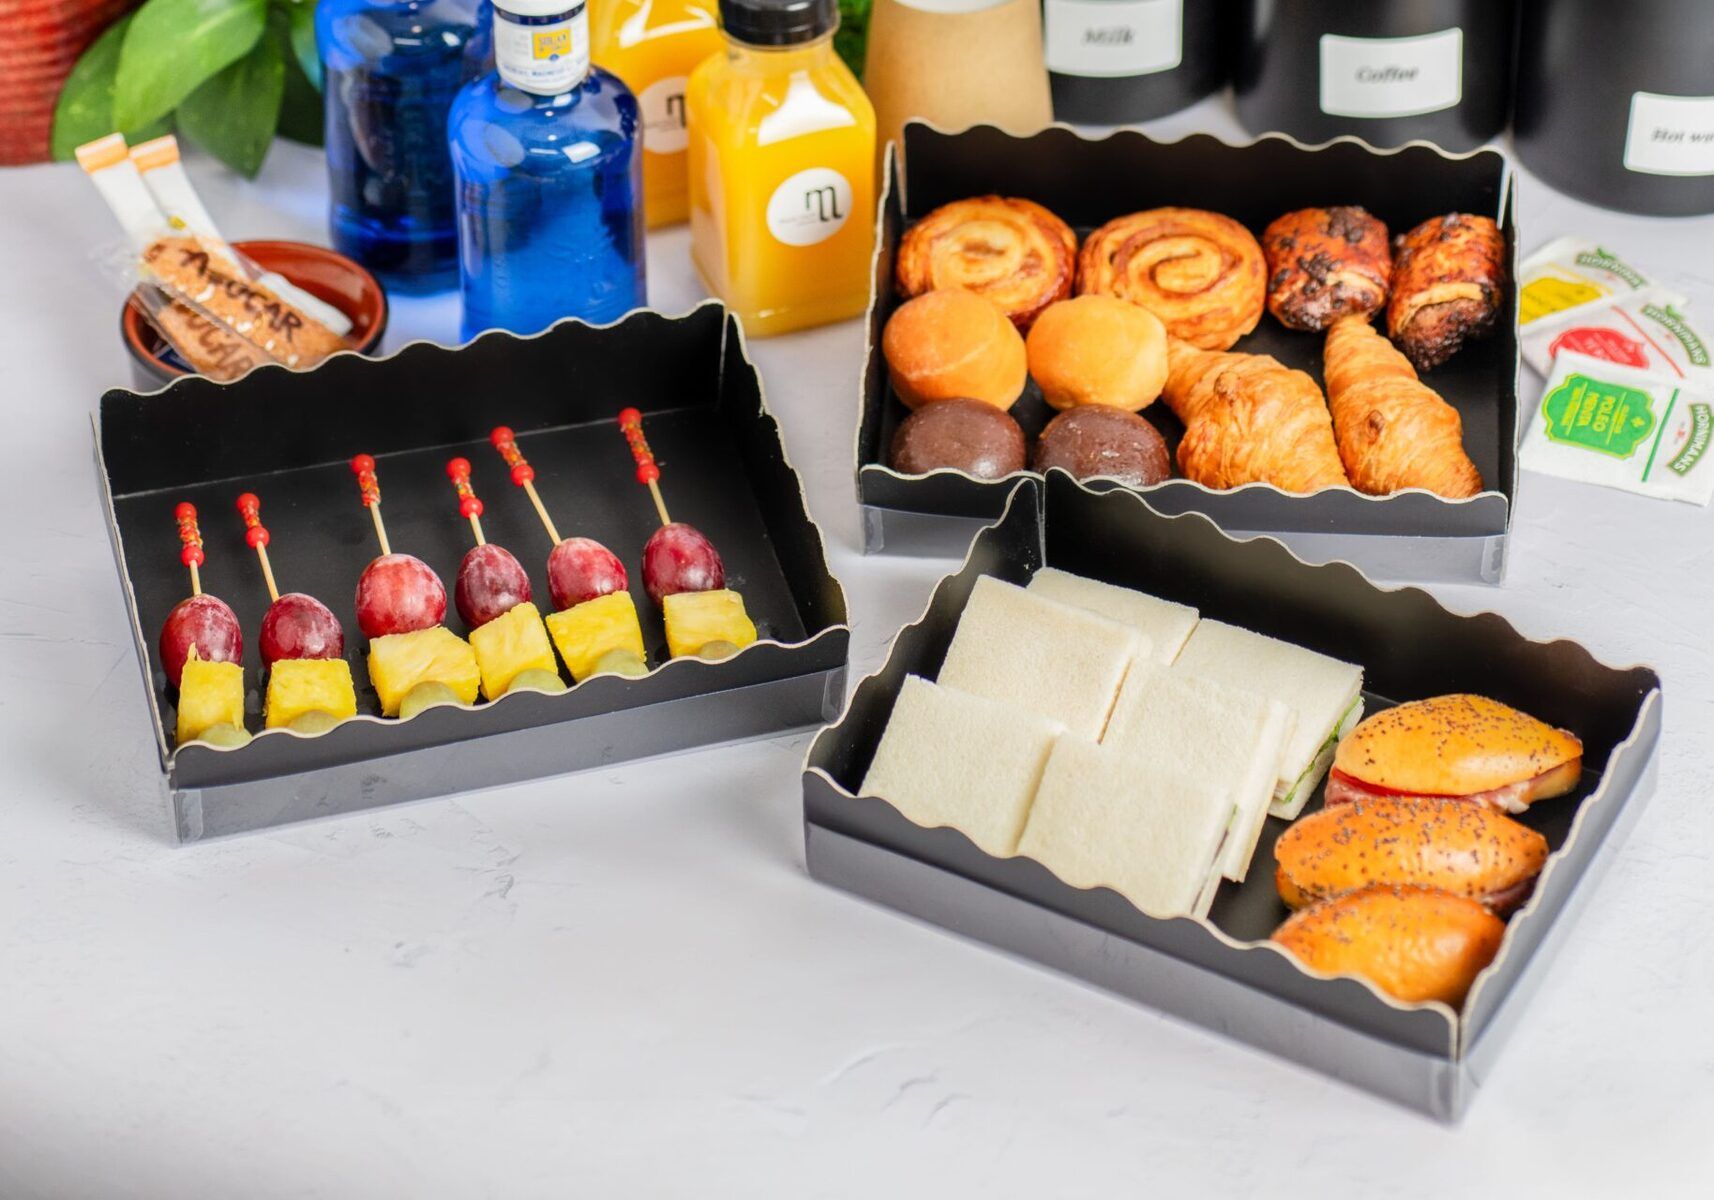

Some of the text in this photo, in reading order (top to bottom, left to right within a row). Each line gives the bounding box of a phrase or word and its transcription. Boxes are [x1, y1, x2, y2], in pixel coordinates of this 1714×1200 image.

[1082, 26, 1134, 46] Milk
[1355, 65, 1419, 84] Coffee
[1652, 127, 1685, 142] Hot
[1674, 404, 1711, 473] HORNIMANS
